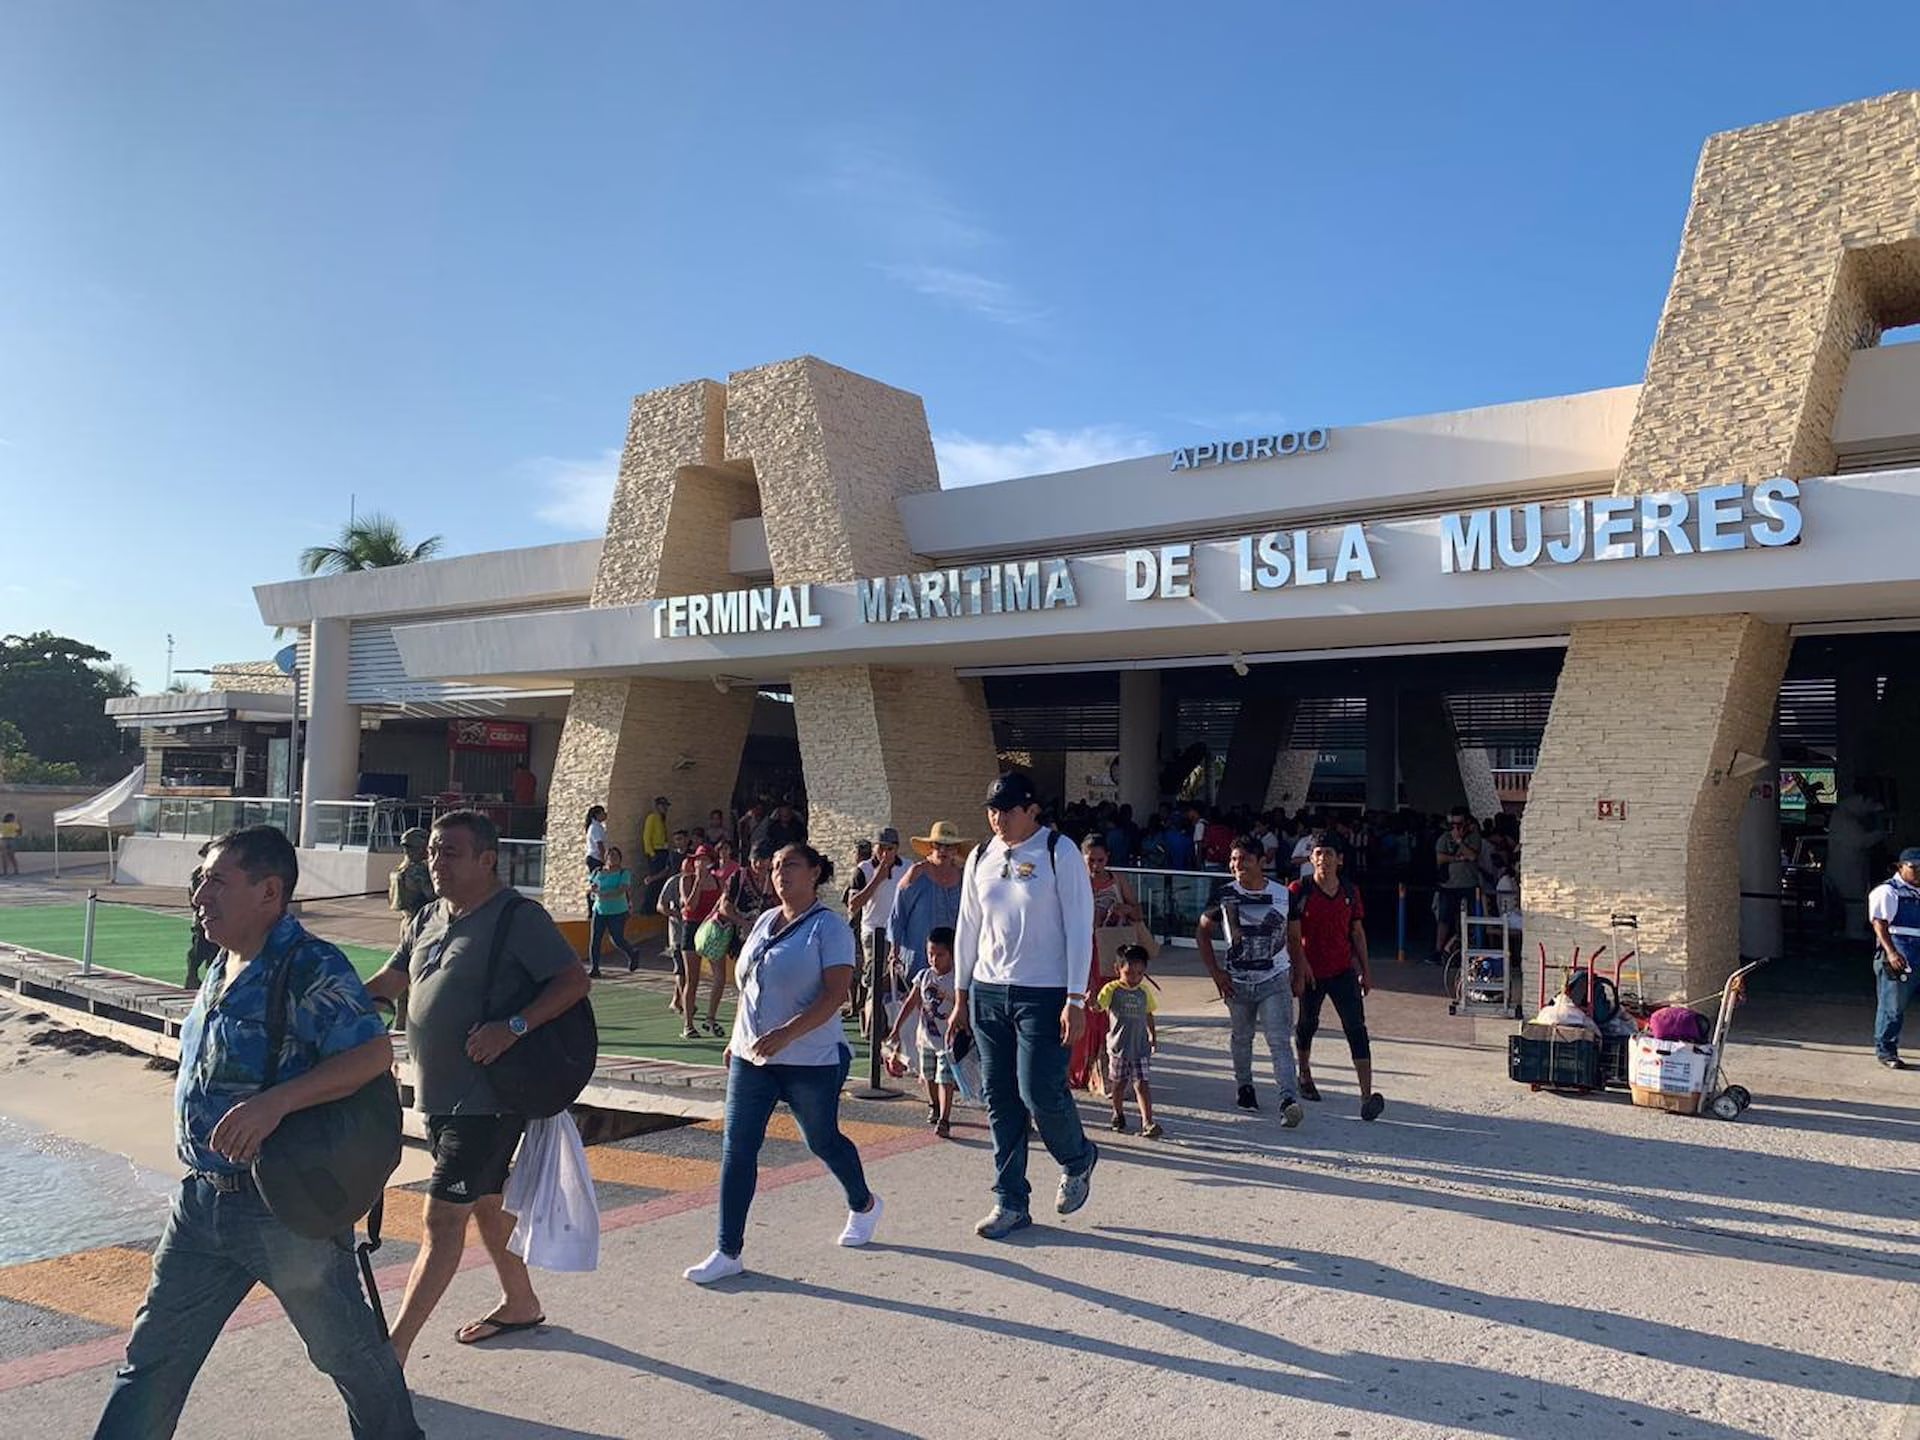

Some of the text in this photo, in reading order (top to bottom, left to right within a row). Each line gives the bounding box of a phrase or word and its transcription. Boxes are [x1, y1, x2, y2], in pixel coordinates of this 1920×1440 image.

[1170, 429, 1328, 472] APIQROO
[651, 477, 1802, 639] TERMINAL MARITIMA DE ISLA MUJERES
